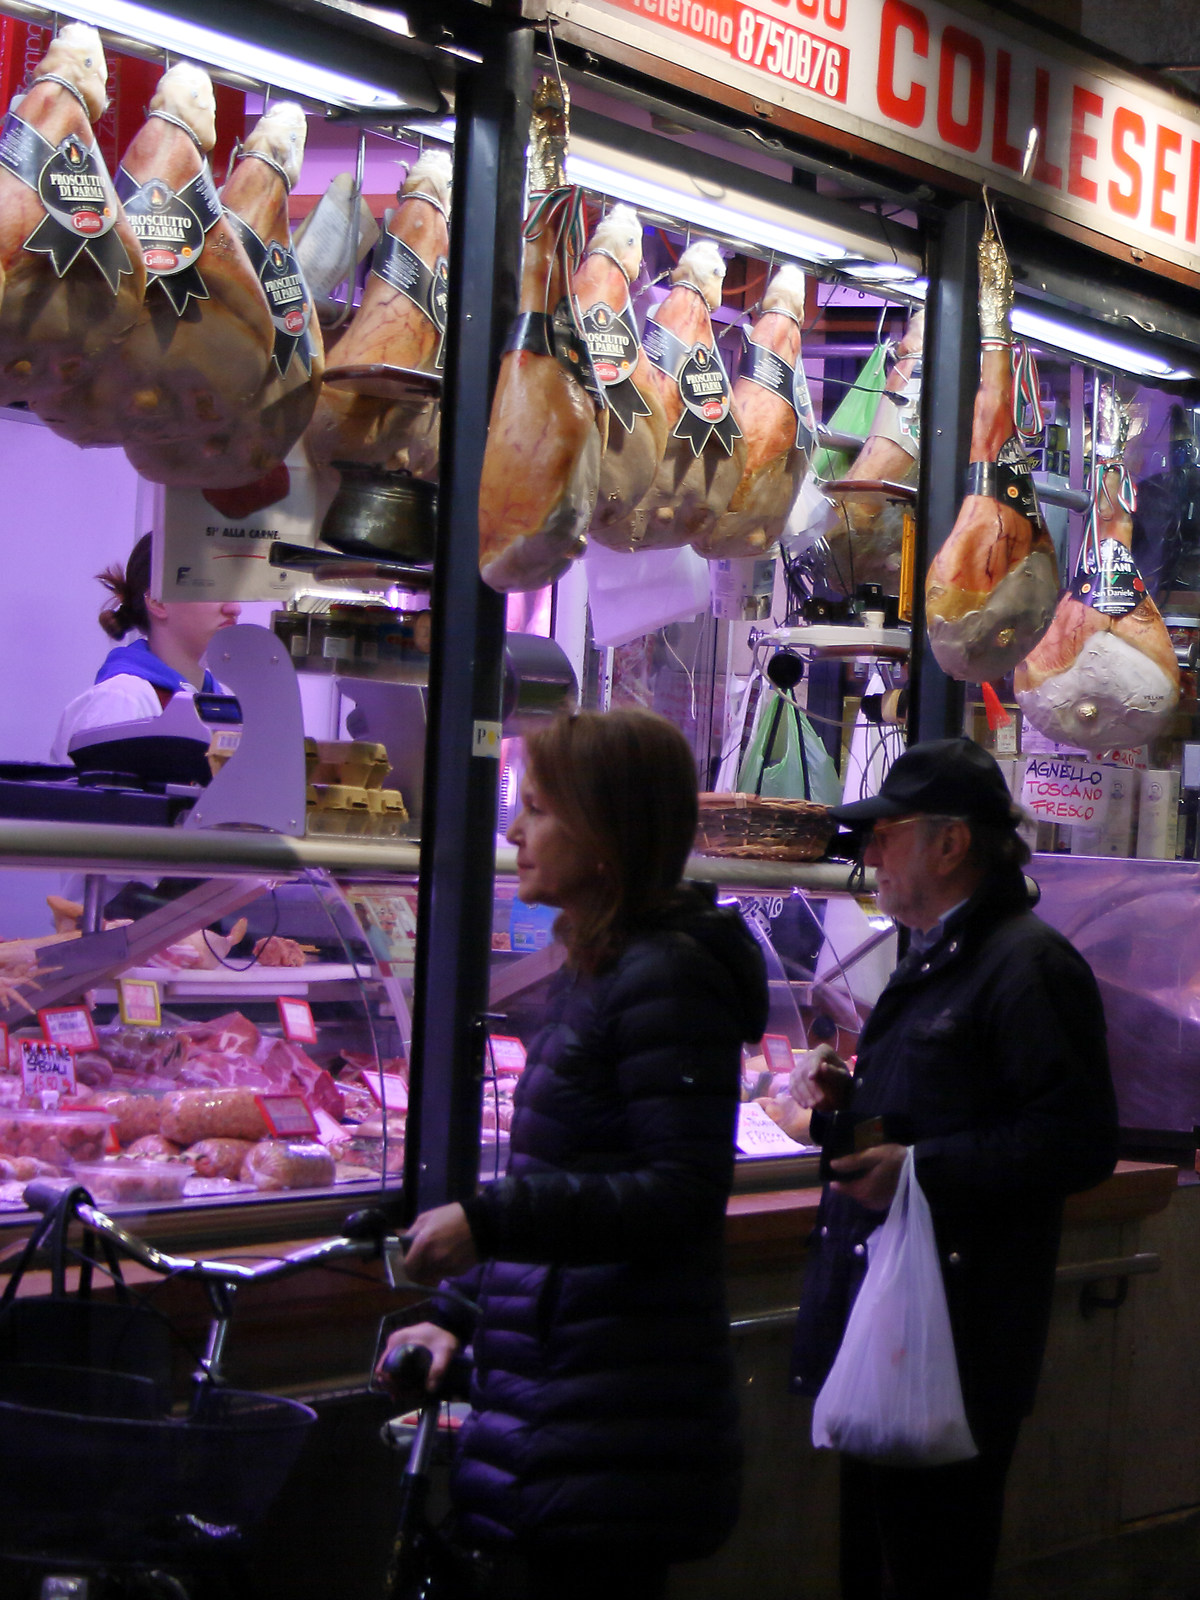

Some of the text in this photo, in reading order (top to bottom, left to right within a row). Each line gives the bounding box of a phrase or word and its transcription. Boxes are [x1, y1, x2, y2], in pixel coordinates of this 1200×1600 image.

[49, 173, 106, 187] PROSCIUTTO
[59, 185, 104, 199] DI PARMA
[126, 214, 192, 229] PROSCIUTTO
[147, 225, 185, 239] PARMA
[596, 343, 625, 355] PARMA
[1107, 588, 1135, 599] Daniele
[1025, 758, 1102, 786] AGNELLO
[1026, 779, 1103, 801] TOSCANO
[1029, 799, 1094, 821] FRESCO
